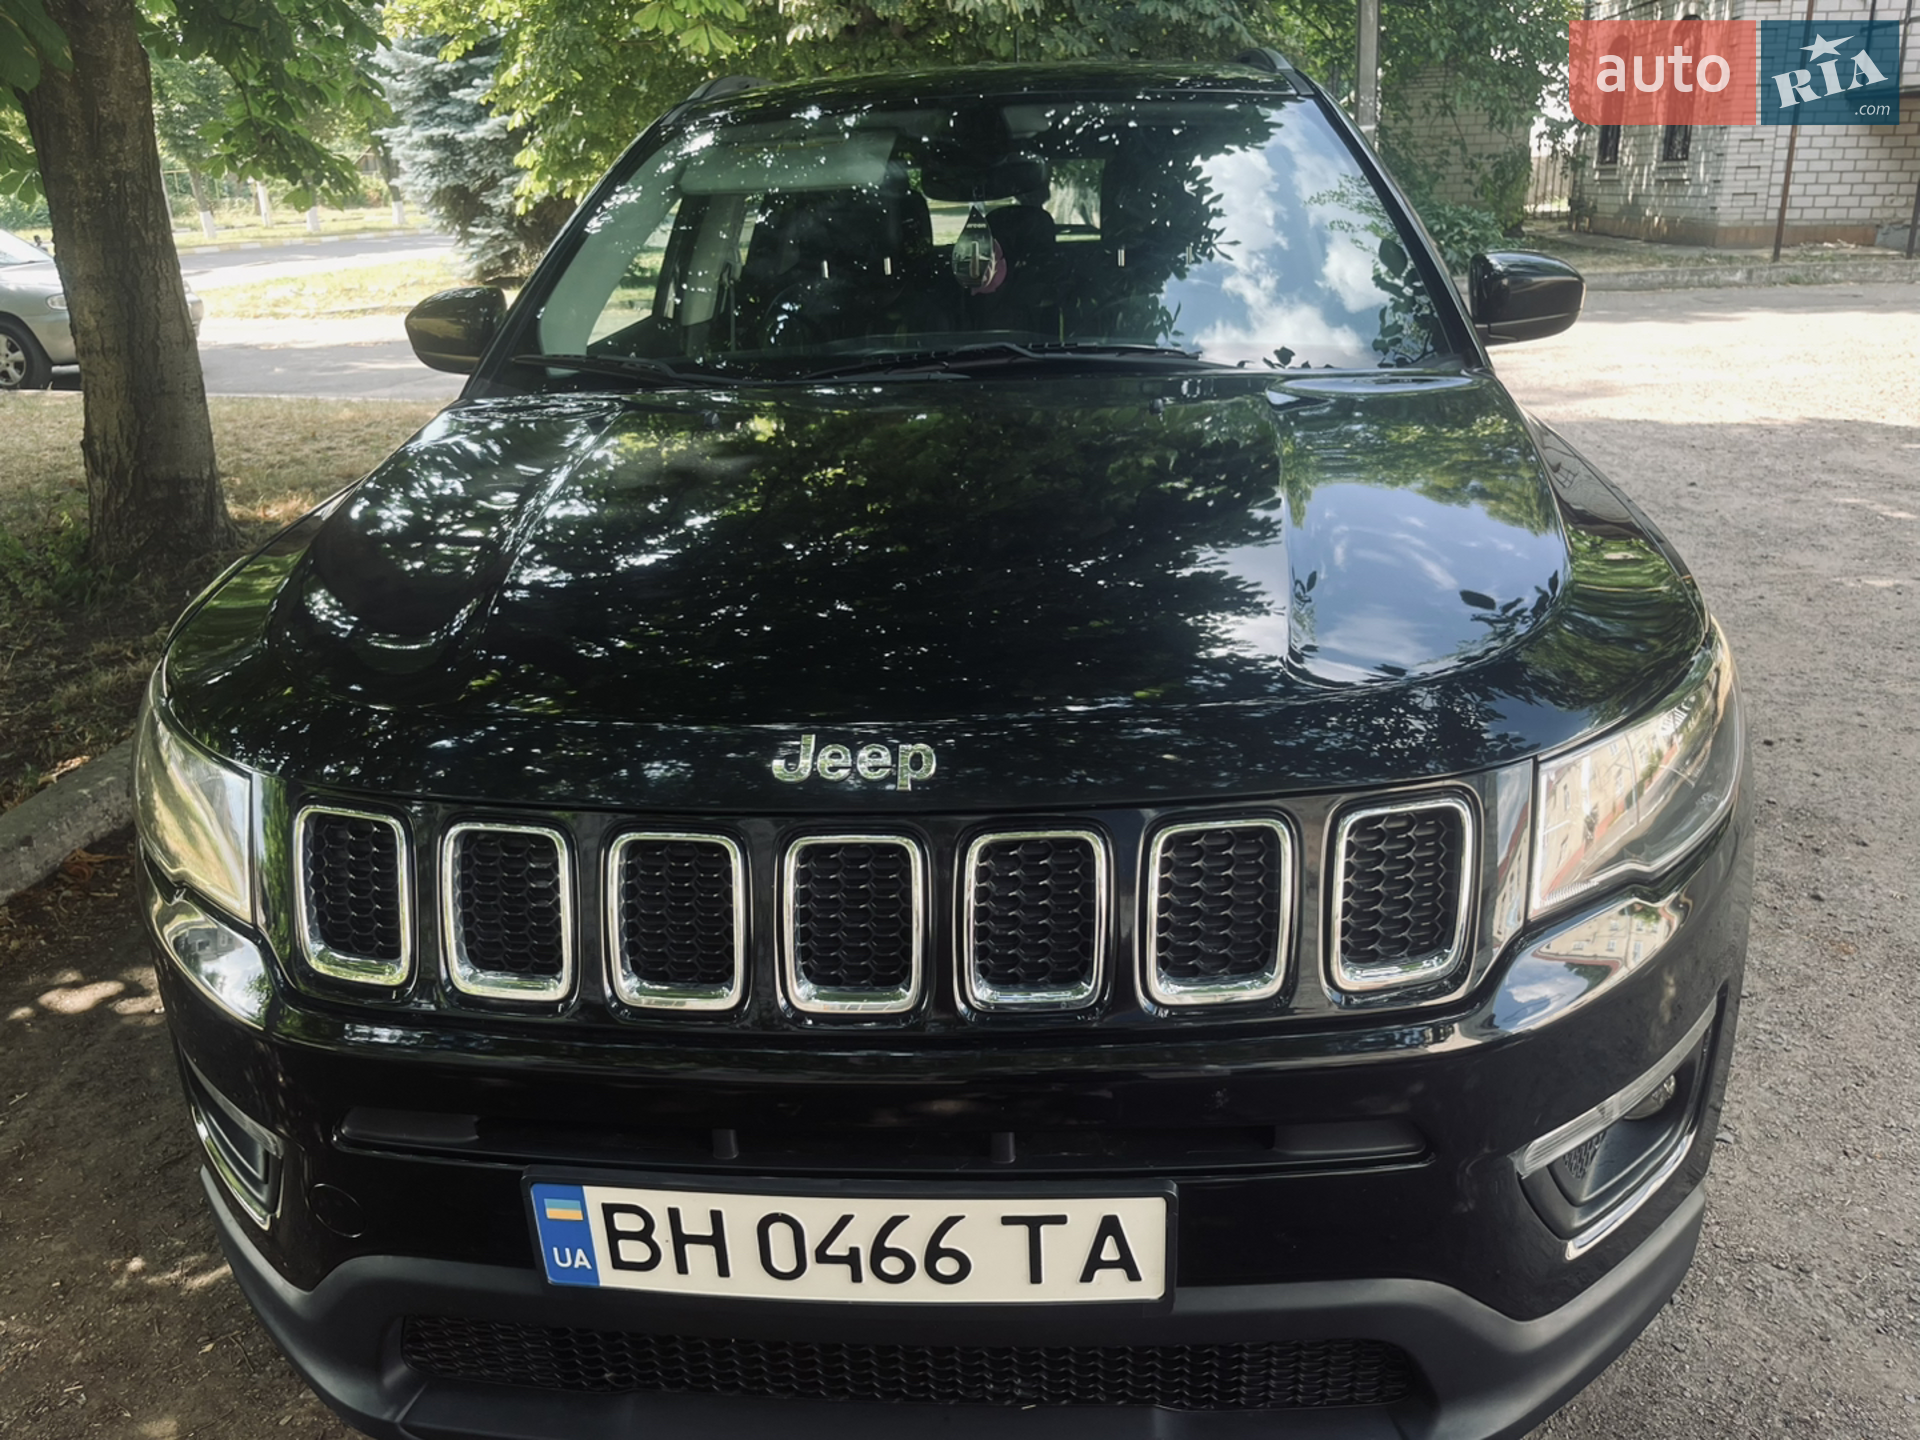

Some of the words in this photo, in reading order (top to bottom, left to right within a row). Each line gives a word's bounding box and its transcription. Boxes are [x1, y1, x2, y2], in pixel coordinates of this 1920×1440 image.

[772, 734, 937, 791] Jeep
[553, 1247, 592, 1269] UA
[601, 1202, 732, 1278] BH
[756, 1212, 973, 1286] 0466
[1000, 1214, 1143, 1285] TA
